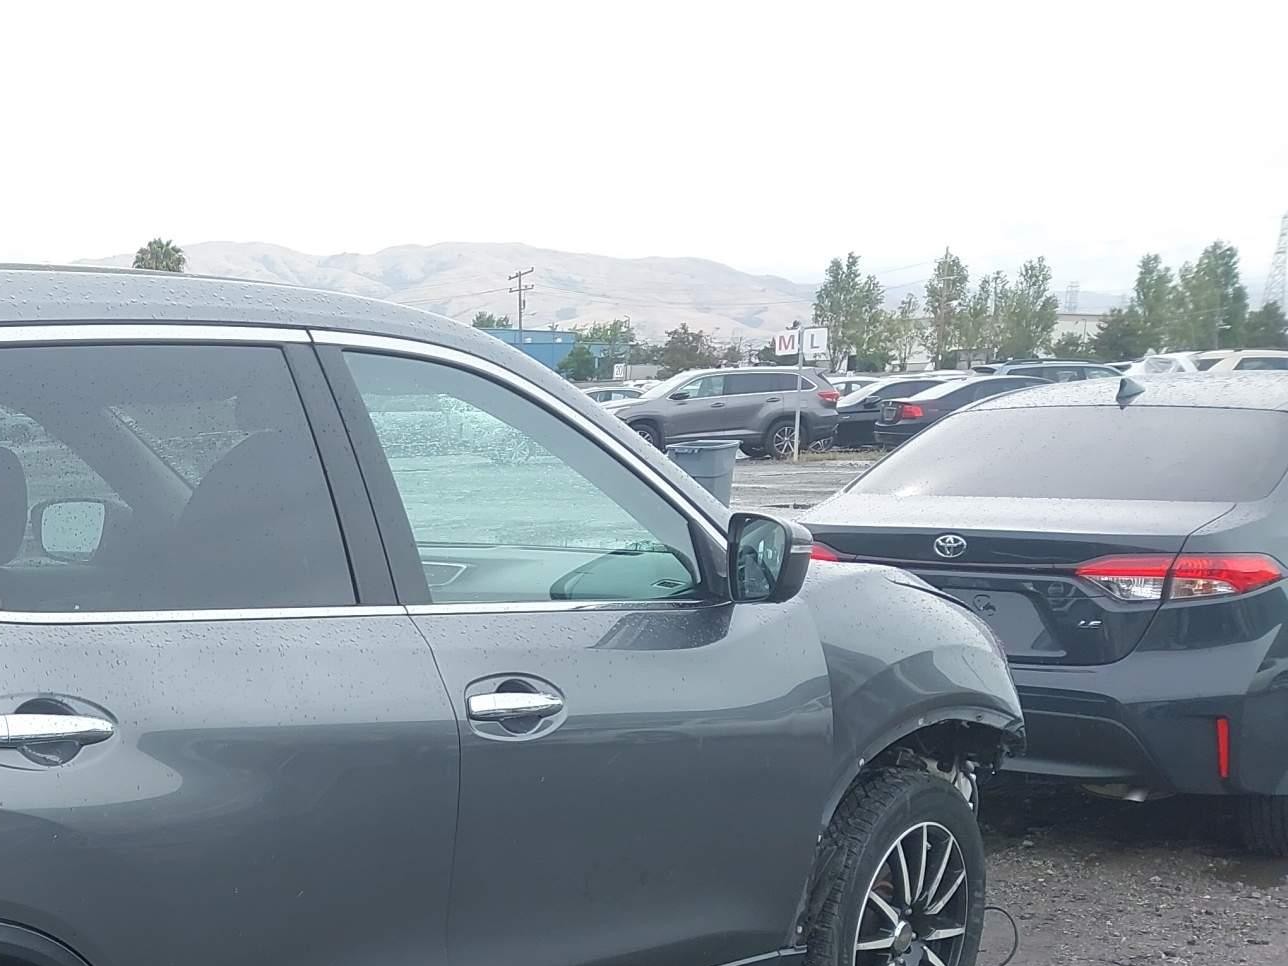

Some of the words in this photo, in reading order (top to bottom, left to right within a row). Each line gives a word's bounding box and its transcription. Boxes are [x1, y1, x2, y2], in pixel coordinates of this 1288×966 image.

[778, 335, 795, 351] M
[810, 334, 820, 349] L
[1077, 620, 1102, 629] LE
